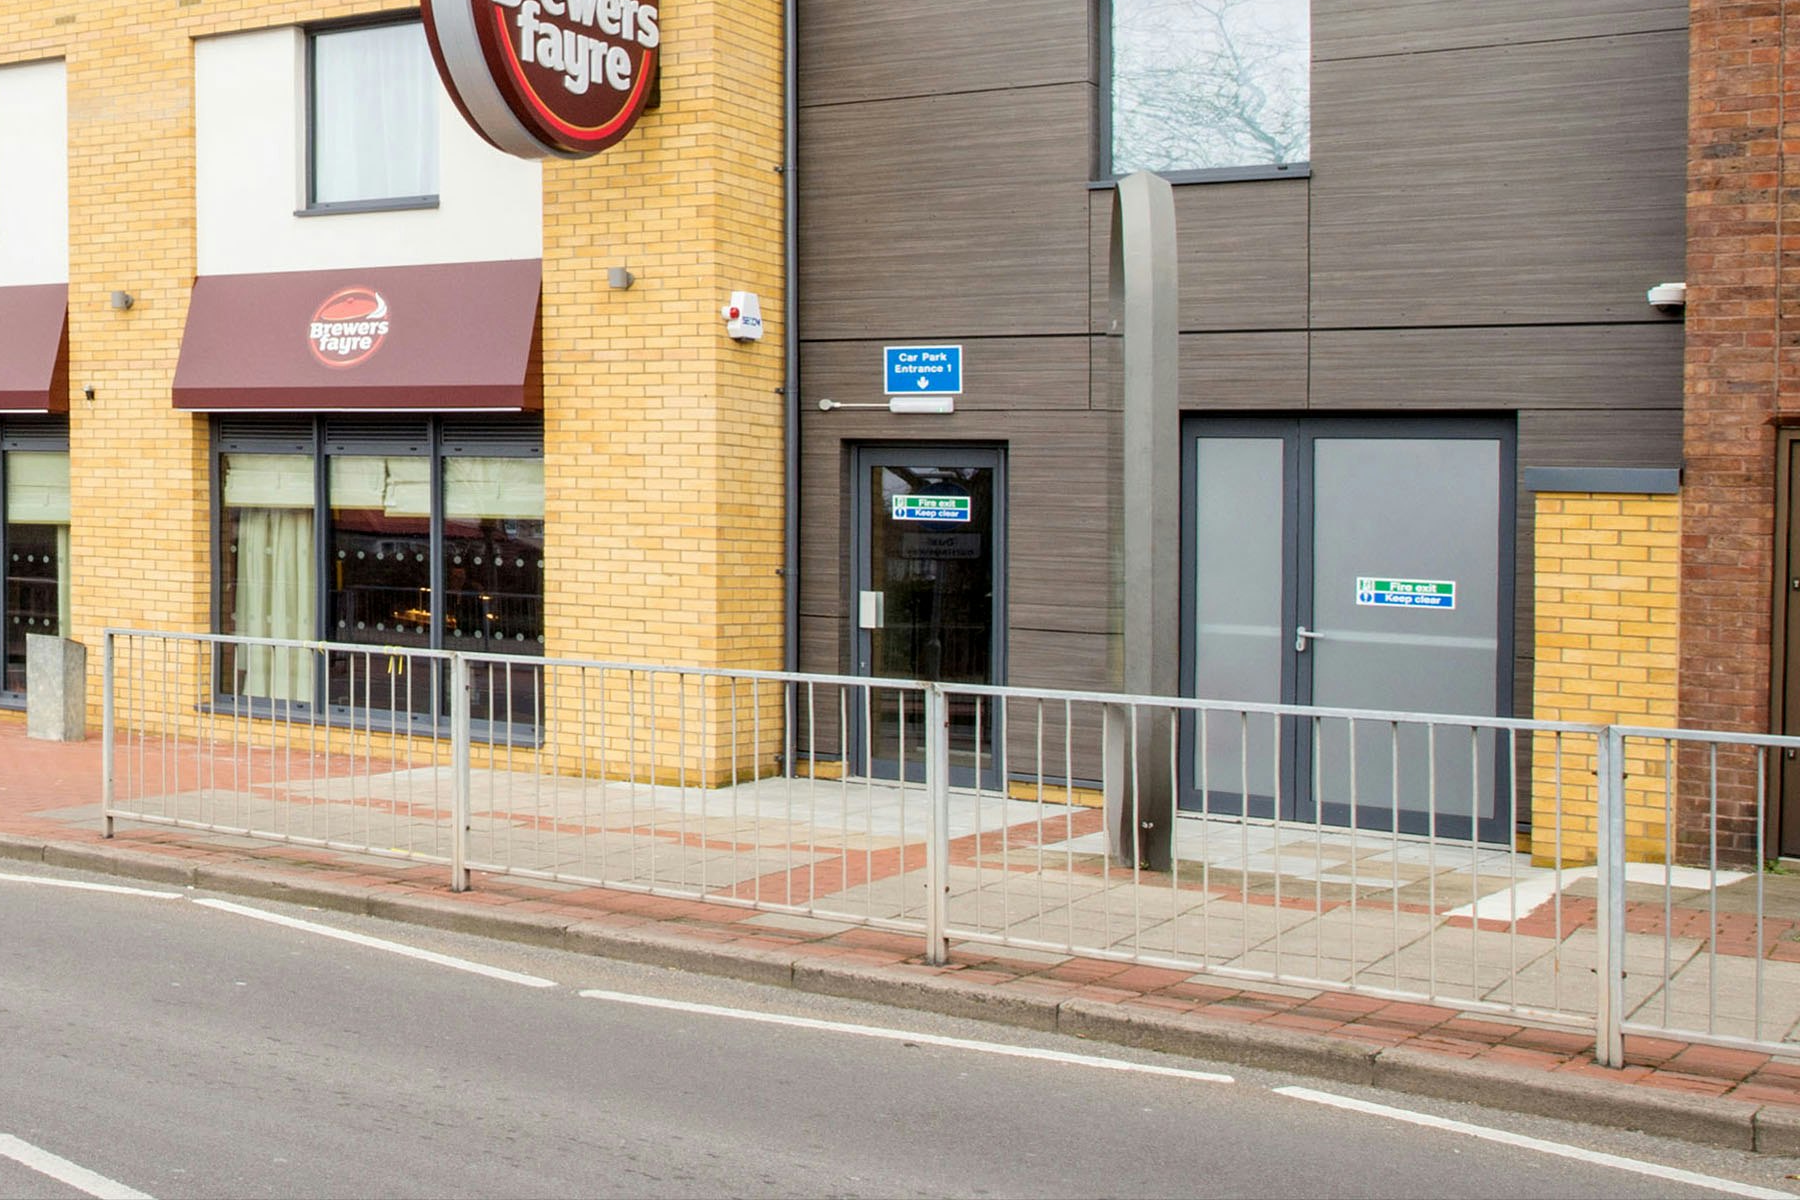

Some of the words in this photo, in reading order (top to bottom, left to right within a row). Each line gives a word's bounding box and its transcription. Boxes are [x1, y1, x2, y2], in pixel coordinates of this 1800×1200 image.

[310, 321, 389, 338] Brewers
[319, 334, 372, 355] fayre
[898, 352, 918, 362] Car
[921, 352, 947, 361] Park
[894, 364, 944, 373] Entrance
[946, 363, 952, 373] 1
[918, 498, 937, 507] Fire
[938, 500, 956, 508] exit
[915, 508, 937, 518] Keep
[938, 509, 959, 518] clear
[1390, 582, 1413, 592] Fire
[1415, 583, 1437, 593] exit
[1385, 594, 1412, 605] Keep
[1414, 596, 1441, 605] clear
